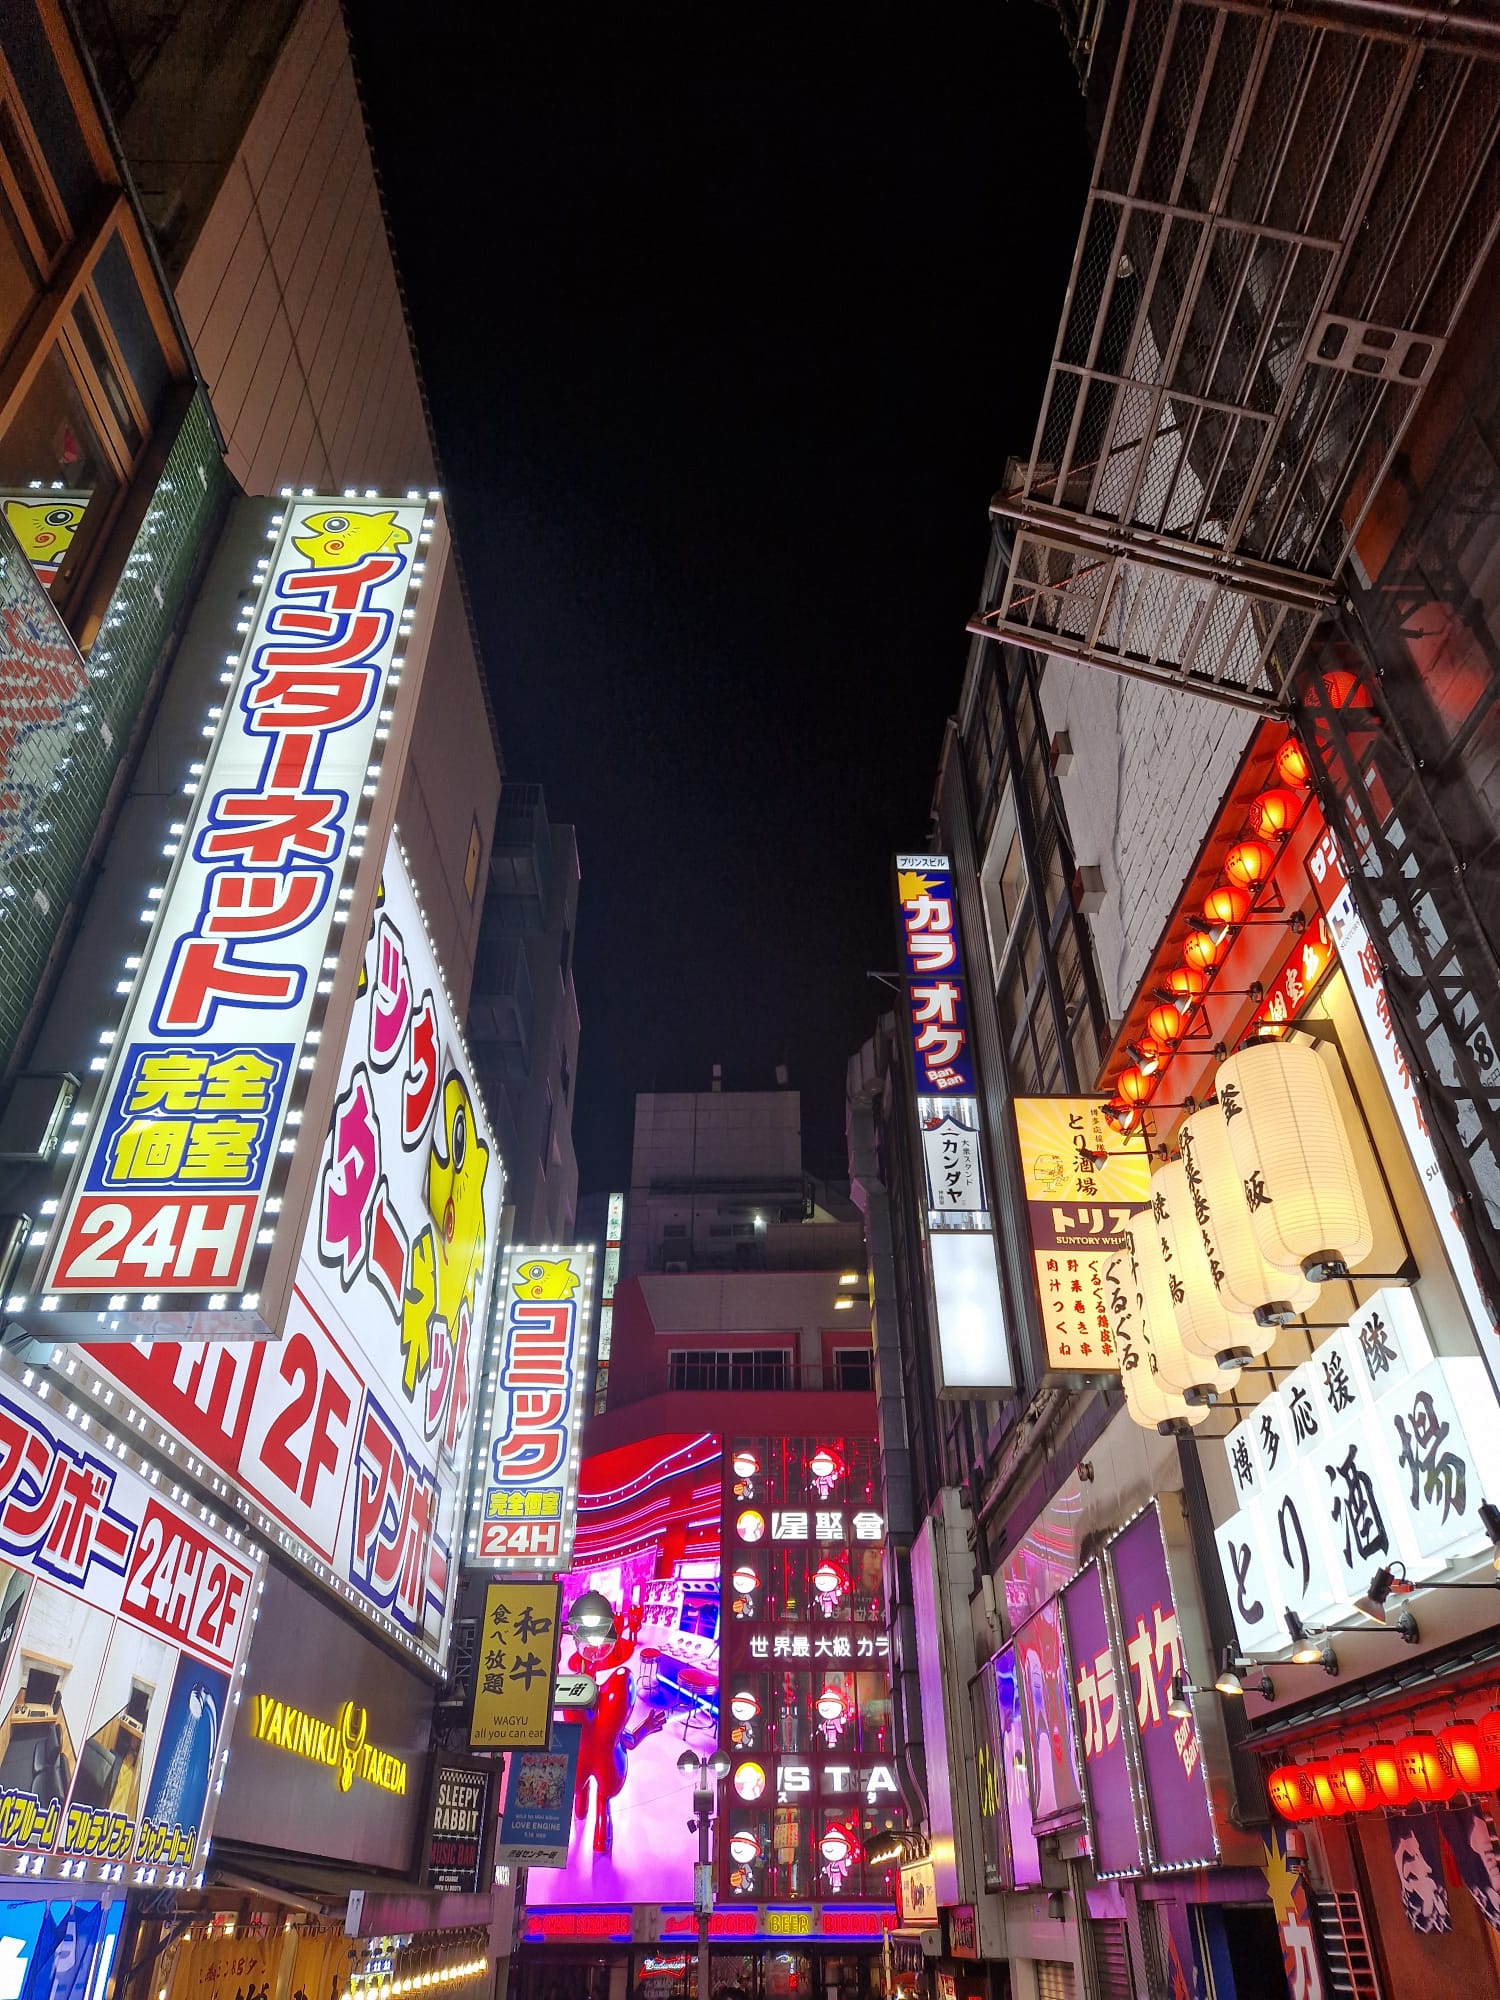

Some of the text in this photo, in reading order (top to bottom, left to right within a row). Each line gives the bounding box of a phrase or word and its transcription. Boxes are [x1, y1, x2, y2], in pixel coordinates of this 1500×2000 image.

[153, 554, 404, 1037] インターネット
[900, 856, 945, 867] プリンスビル
[904, 894, 964, 1067] カラオケ
[129, 1051, 282, 1115] 完全
[928, 1066, 954, 1082] Ban
[937, 1073, 963, 1091] Ban
[107, 1117, 260, 1186] 個室
[943, 1139, 962, 1203] カンダヤ
[1069, 1113, 1098, 1196] とり酒場
[68, 1203, 245, 1280] 24H
[1056, 1236, 1101, 1245] SUNTORY
[1047, 1259, 1071, 1356] 肉汁つくね
[1067, 1259, 1092, 1356] 野菜巻き串
[259, 1332, 351, 1509] 2F
[493, 1300, 577, 1485] コミック
[1231, 1311, 1398, 1491] 博多応援隊
[351, 1390, 446, 1637] マンボー
[488, 1489, 562, 1519] 完全個室
[1228, 1391, 1466, 1625] とり酒場
[484, 1524, 556, 1554] 24H
[127, 1517, 245, 1648] 24H 2F
[482, 1604, 511, 1694] 食べ放題
[509, 1607, 552, 1691] 和牛
[1077, 1601, 1181, 1760] カラオケ
[259, 1695, 408, 1795] YAKINIKU TAKEDA
[475, 1728, 543, 1741] all you can eat
[493, 1715, 528, 1725] WAGYU
[434, 1807, 479, 1832] RABBIT
[439, 1784, 479, 1808] SLEEPY
[511, 1821, 561, 1831] LOVE ENGINE
[64, 1803, 137, 1860] マルチソファ
[134, 1817, 196, 1868] シャワールーム
[431, 1842, 476, 1866] MUSIC BAR
[770, 1914, 810, 1935] BEER
[822, 1913, 879, 1934] BIRRIA
